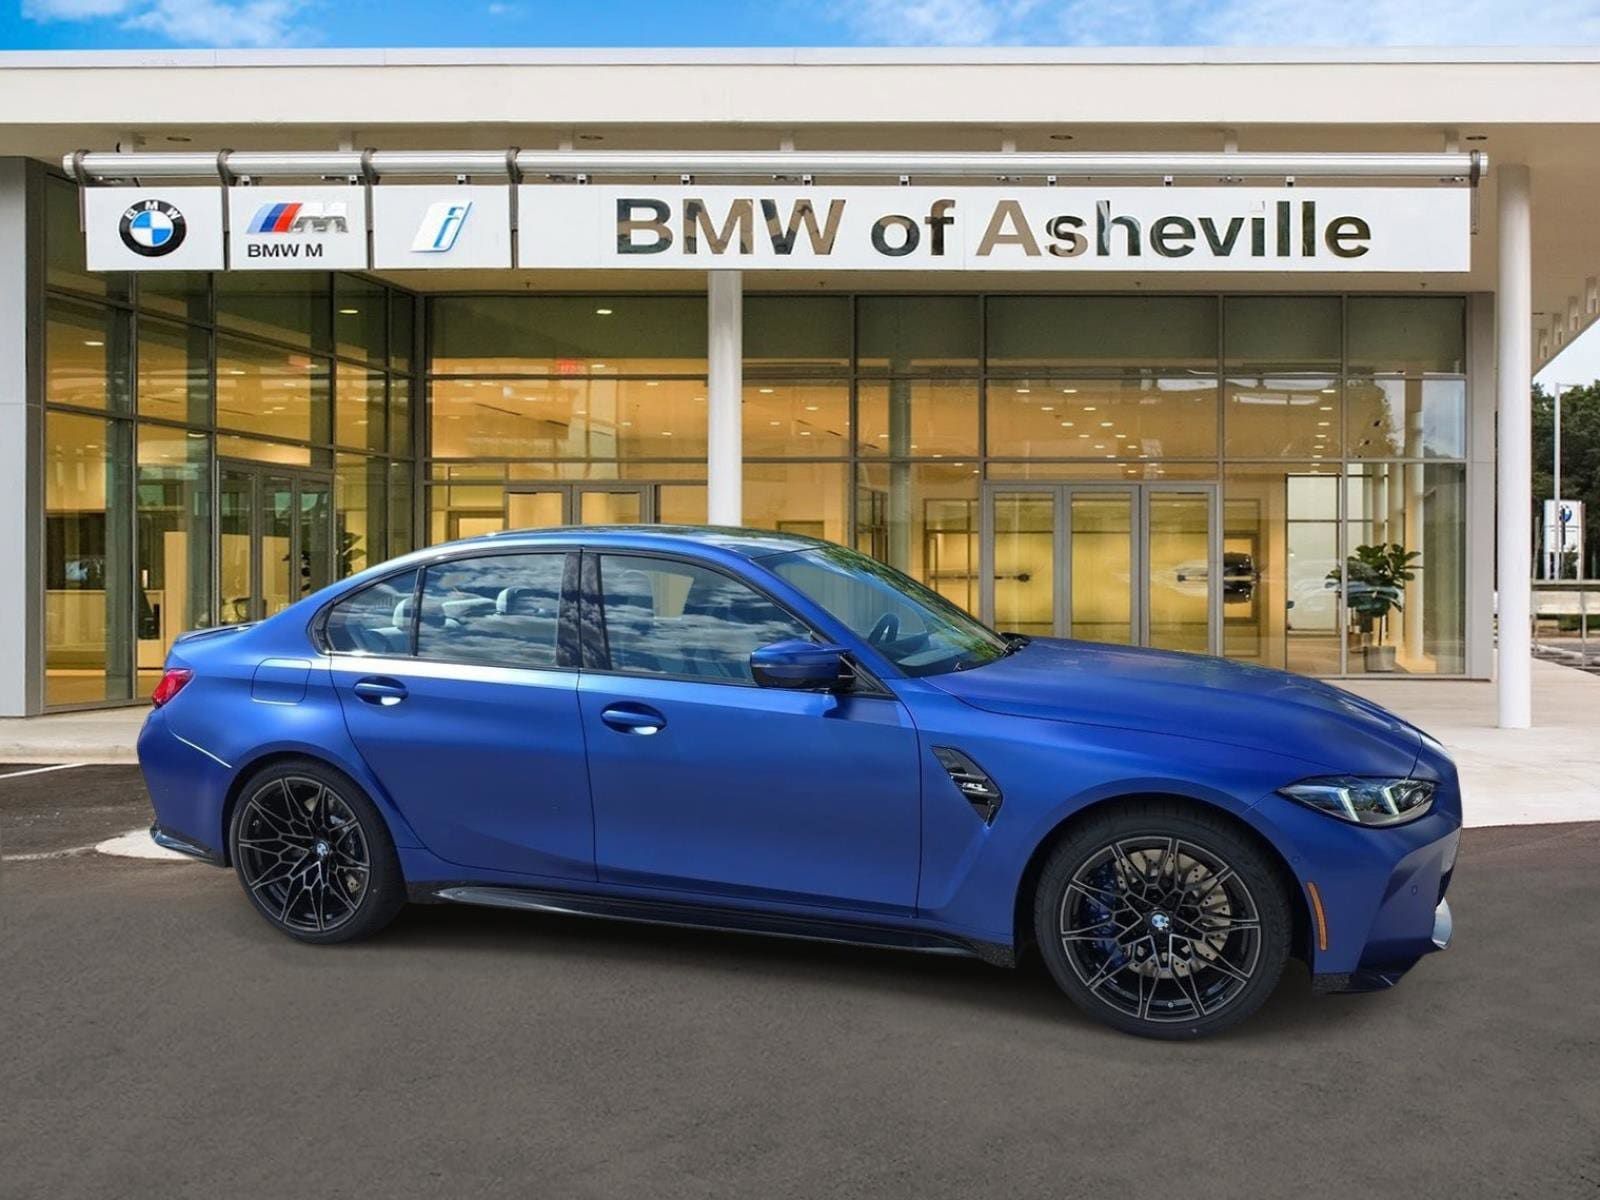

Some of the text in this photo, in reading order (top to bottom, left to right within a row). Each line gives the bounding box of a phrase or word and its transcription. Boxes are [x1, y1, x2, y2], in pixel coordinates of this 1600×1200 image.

[124, 200, 181, 220] BMW
[616, 198, 1372, 259] BMW of Asheville
[247, 243, 323, 258] BMW M
